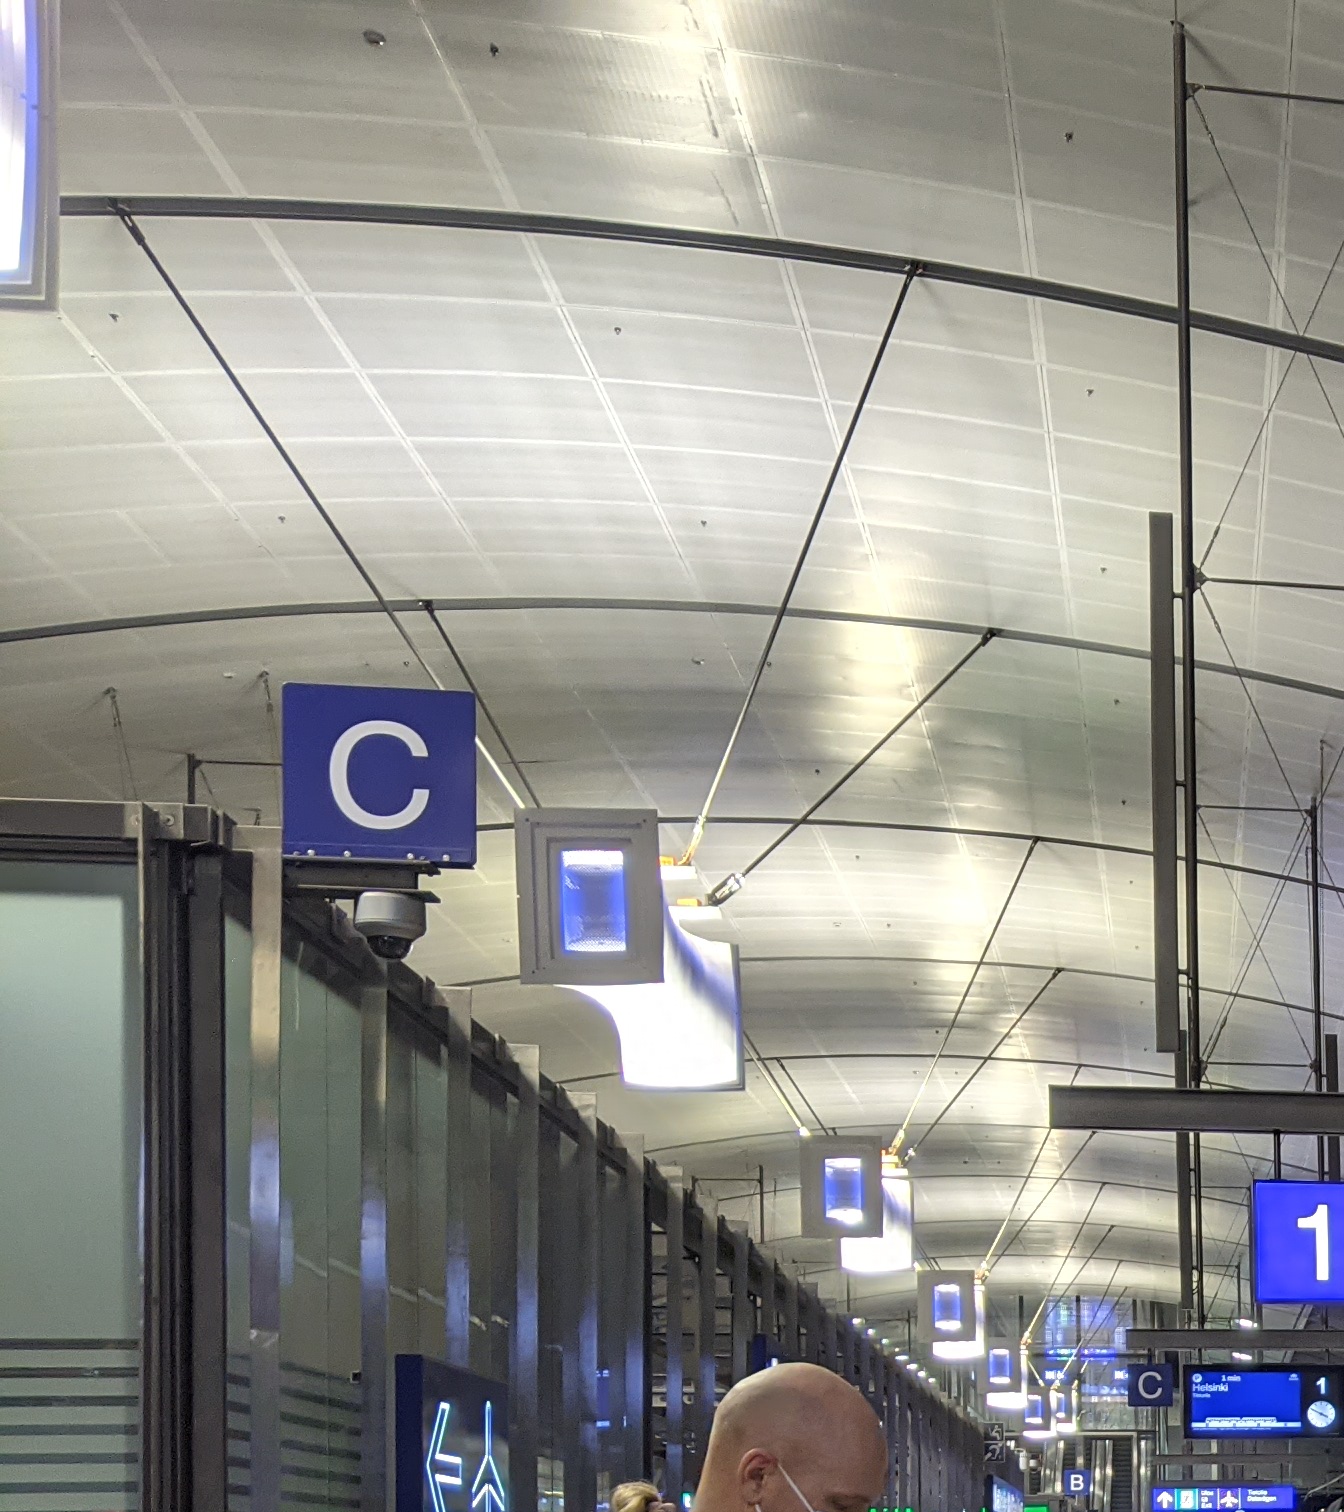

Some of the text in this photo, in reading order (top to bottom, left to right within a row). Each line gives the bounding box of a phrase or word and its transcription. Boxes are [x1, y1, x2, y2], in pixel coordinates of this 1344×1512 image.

[329, 719, 430, 830] C
[1297, 1204, 1329, 1281] 1
[1137, 1371, 1163, 1400] C
[1192, 1383, 1229, 1392] Helsinki
[1315, 1376, 1326, 1395] 1
[1070, 1474, 1085, 1491] B
